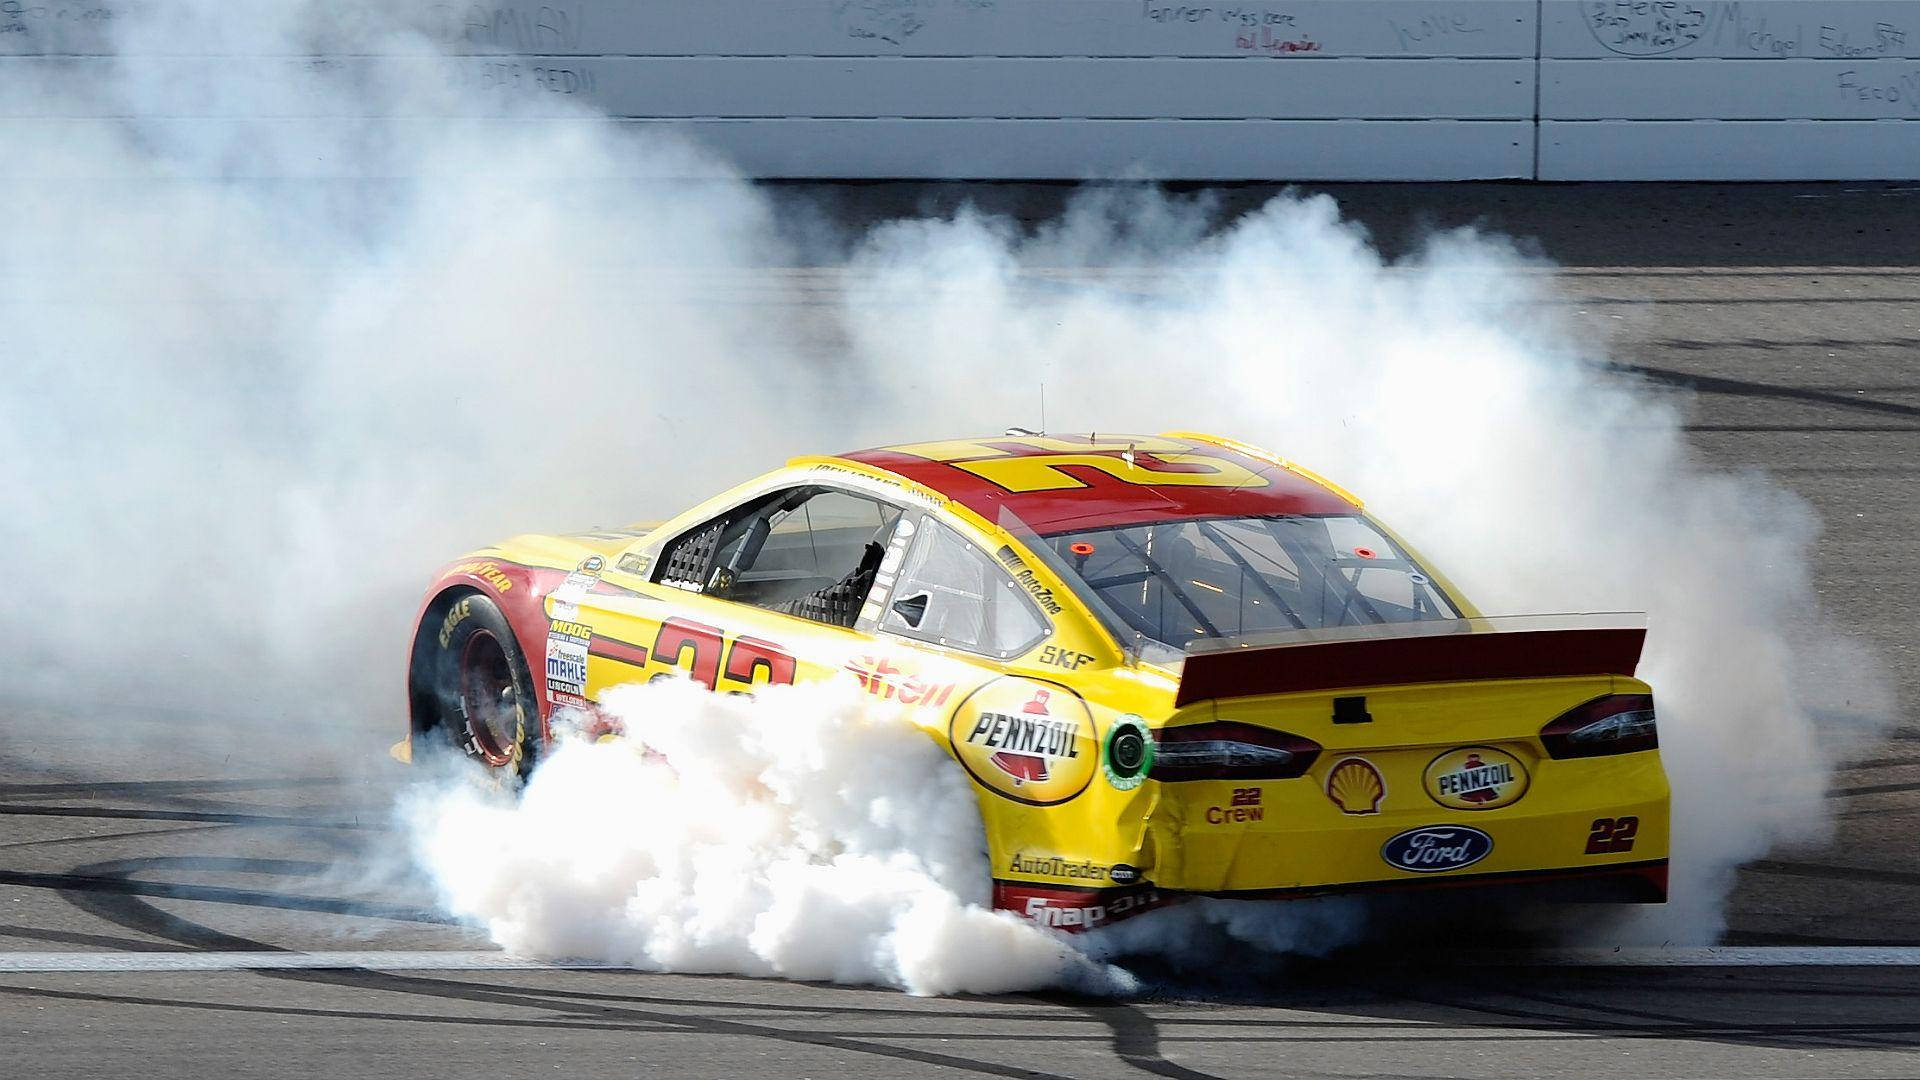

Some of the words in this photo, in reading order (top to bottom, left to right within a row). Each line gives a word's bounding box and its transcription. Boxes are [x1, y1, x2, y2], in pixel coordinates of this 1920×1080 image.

[1143, 0, 1213, 23] Tanner
[1017, 569, 1062, 616] AutoZone
[551, 619, 592, 639] MOOG
[558, 648, 585, 664] freescale
[1038, 645, 1096, 670] SKF
[547, 657, 586, 682] MAHLE
[548, 679, 579, 695] LINCOLN
[968, 712, 1080, 759] PENNZOIL
[1438, 763, 1516, 796] PENNZOIL
[1230, 787, 1263, 806] 22
[1206, 805, 1264, 825] Crew
[1584, 816, 1639, 855] 22
[1402, 832, 1471, 866] Ford
[1009, 853, 1108, 880] AutoTrader
